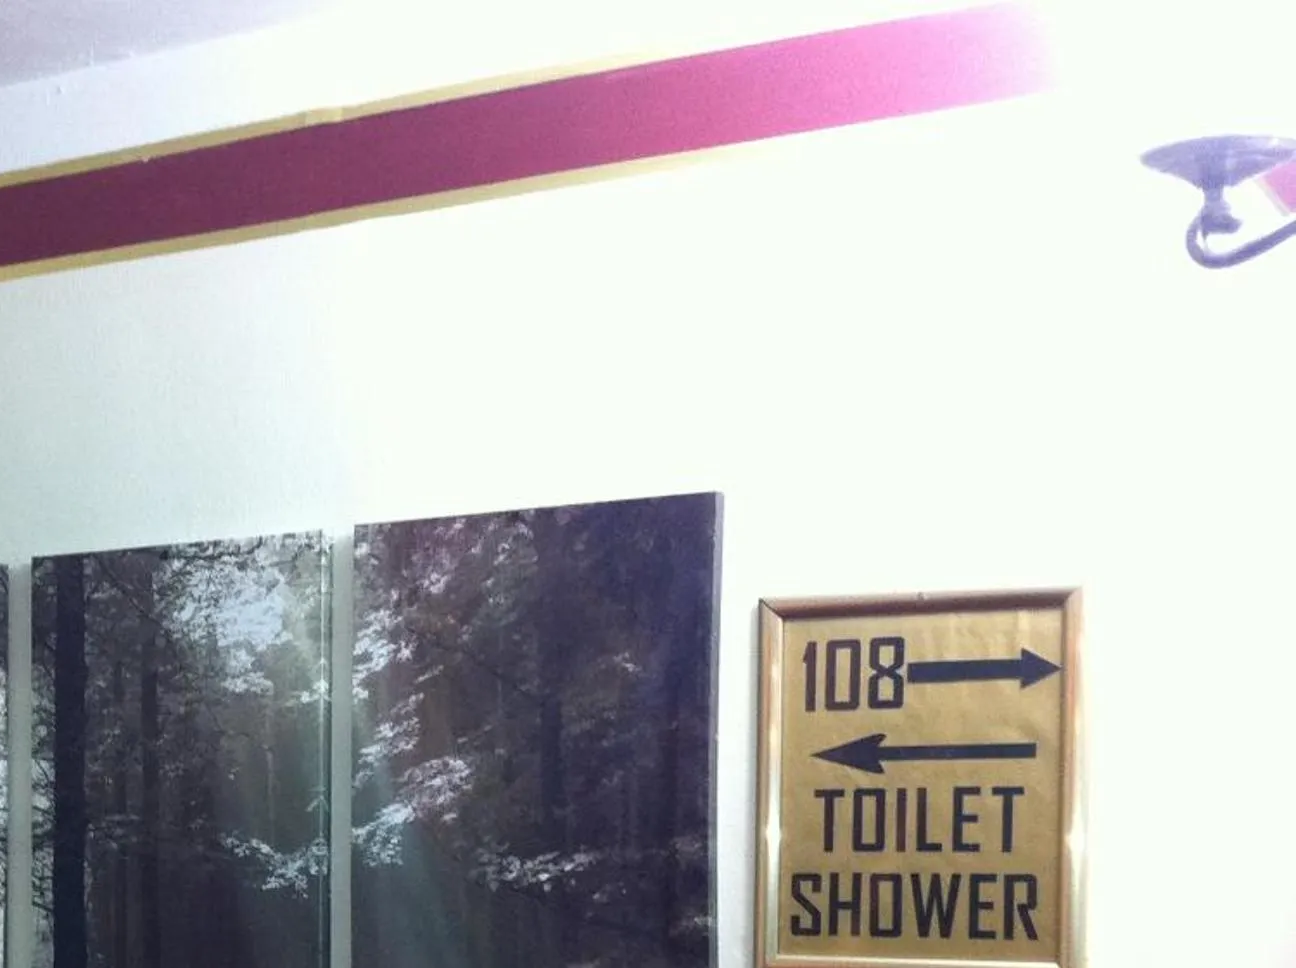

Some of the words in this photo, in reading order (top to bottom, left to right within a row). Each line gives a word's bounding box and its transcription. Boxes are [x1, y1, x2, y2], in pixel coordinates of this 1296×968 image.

[802, 636, 905, 713] 108
[814, 786, 1025, 853] TOILET
[790, 872, 1039, 941] SHOWER
